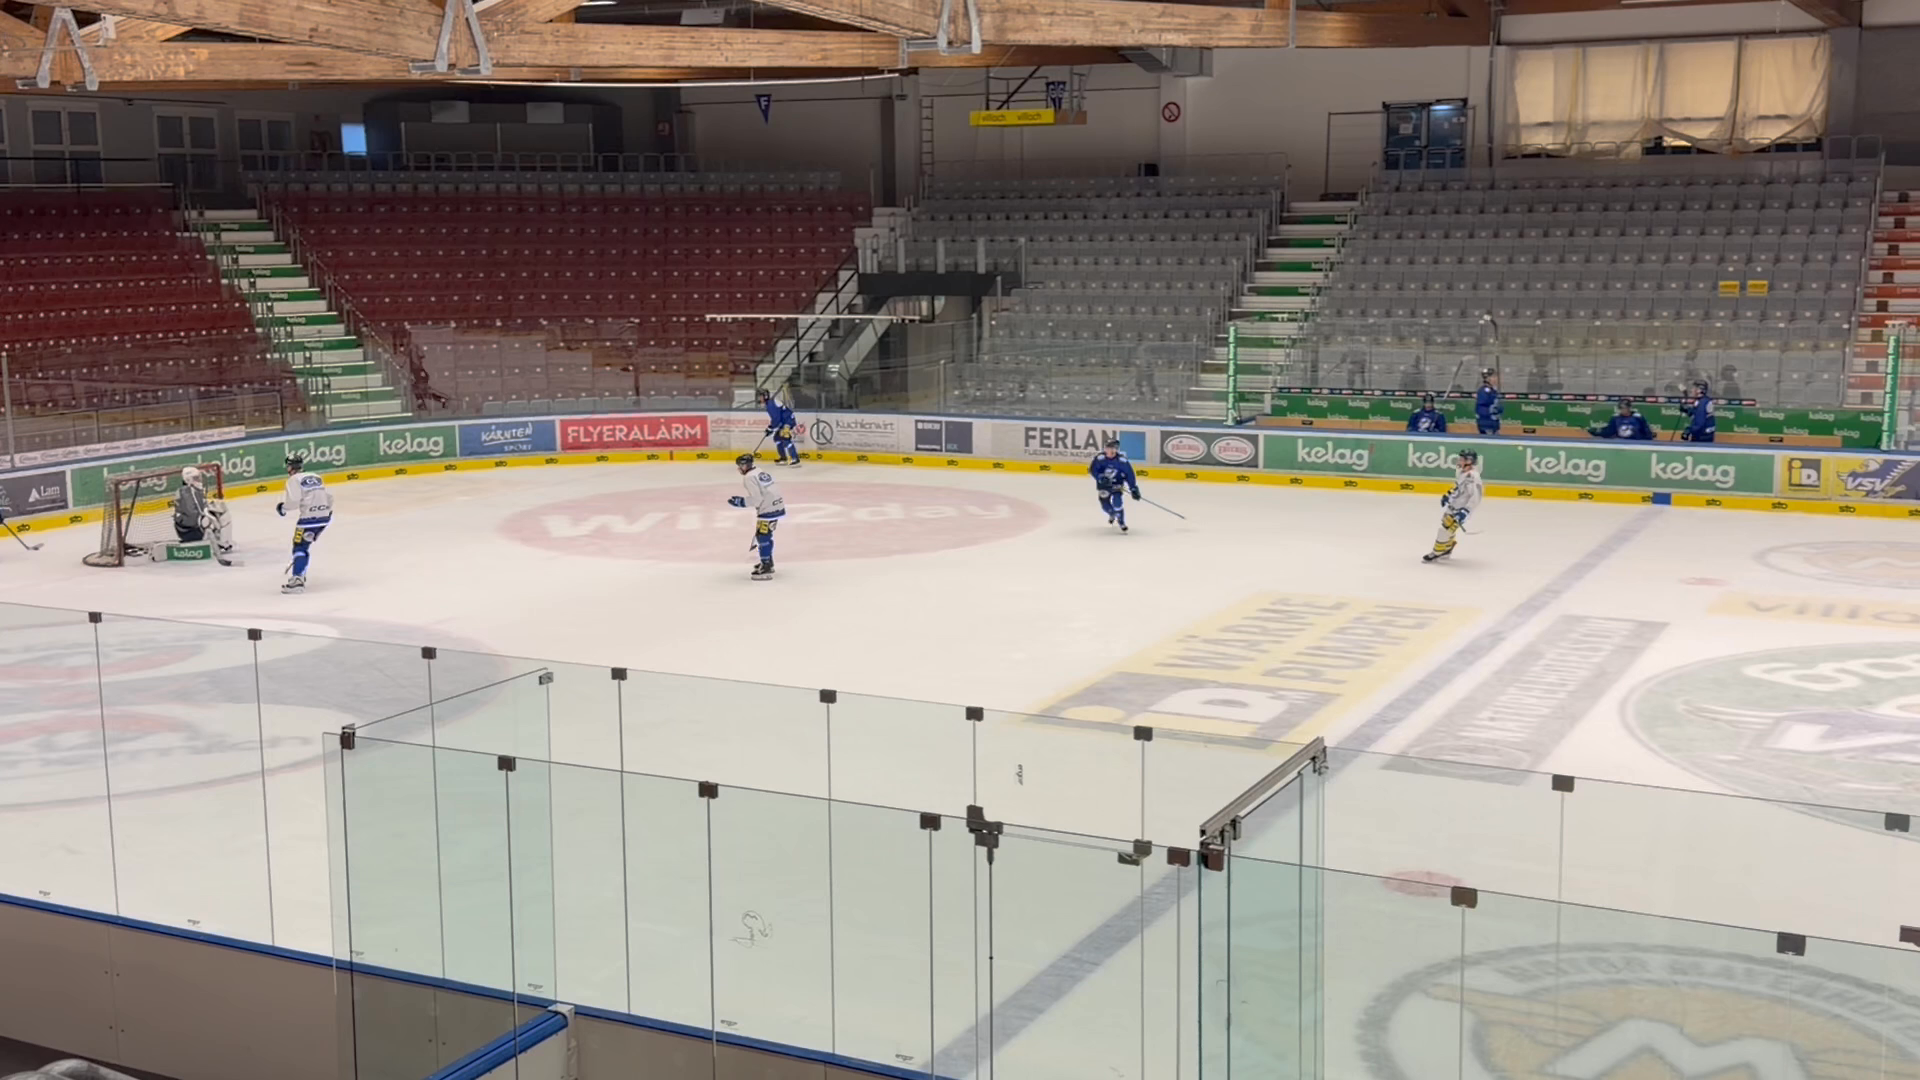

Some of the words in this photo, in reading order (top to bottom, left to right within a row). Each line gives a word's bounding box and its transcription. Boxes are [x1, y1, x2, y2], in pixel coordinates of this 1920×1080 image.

[760, 97, 769, 110] F
[1808, 411, 1835, 422] kelag
[1024, 427, 1116, 451] FERLAN
[379, 432, 444, 456] kelag
[646, 453, 659, 461] sto
[696, 452, 709, 460] sto
[857, 454, 868, 462] sto
[1297, 438, 1369, 471] kelag
[545, 457, 558, 465] sto
[596, 455, 609, 463] sto
[444, 463, 457, 471] sto
[494, 460, 508, 468] sto
[992, 461, 1005, 469] sto
[1526, 448, 1607, 482] kelag
[394, 467, 408, 475] sto
[1136, 469, 1149, 477] sto
[1651, 453, 1736, 488] kelag
[346, 472, 359, 480] sto
[1185, 472, 1198, 480] sto
[1290, 477, 1303, 485] sto
[1343, 479, 1358, 487] sto
[1845, 476, 1889, 491] VSV
[256, 484, 268, 492] sto
[1400, 482, 1414, 491] sto
[1517, 488, 1532, 497] sto
[1578, 492, 1594, 500] sto
[1641, 495, 1653, 503] st
[1705, 498, 1722, 507] sto
[1771, 501, 1788, 509] sto
[1838, 504, 1856, 513] sto
[69, 515, 83, 524] sto
[16, 523, 31, 532] sto
[1153, 597, 1352, 671] WÄRME
[1260, 604, 1448, 685] PUMPEN
